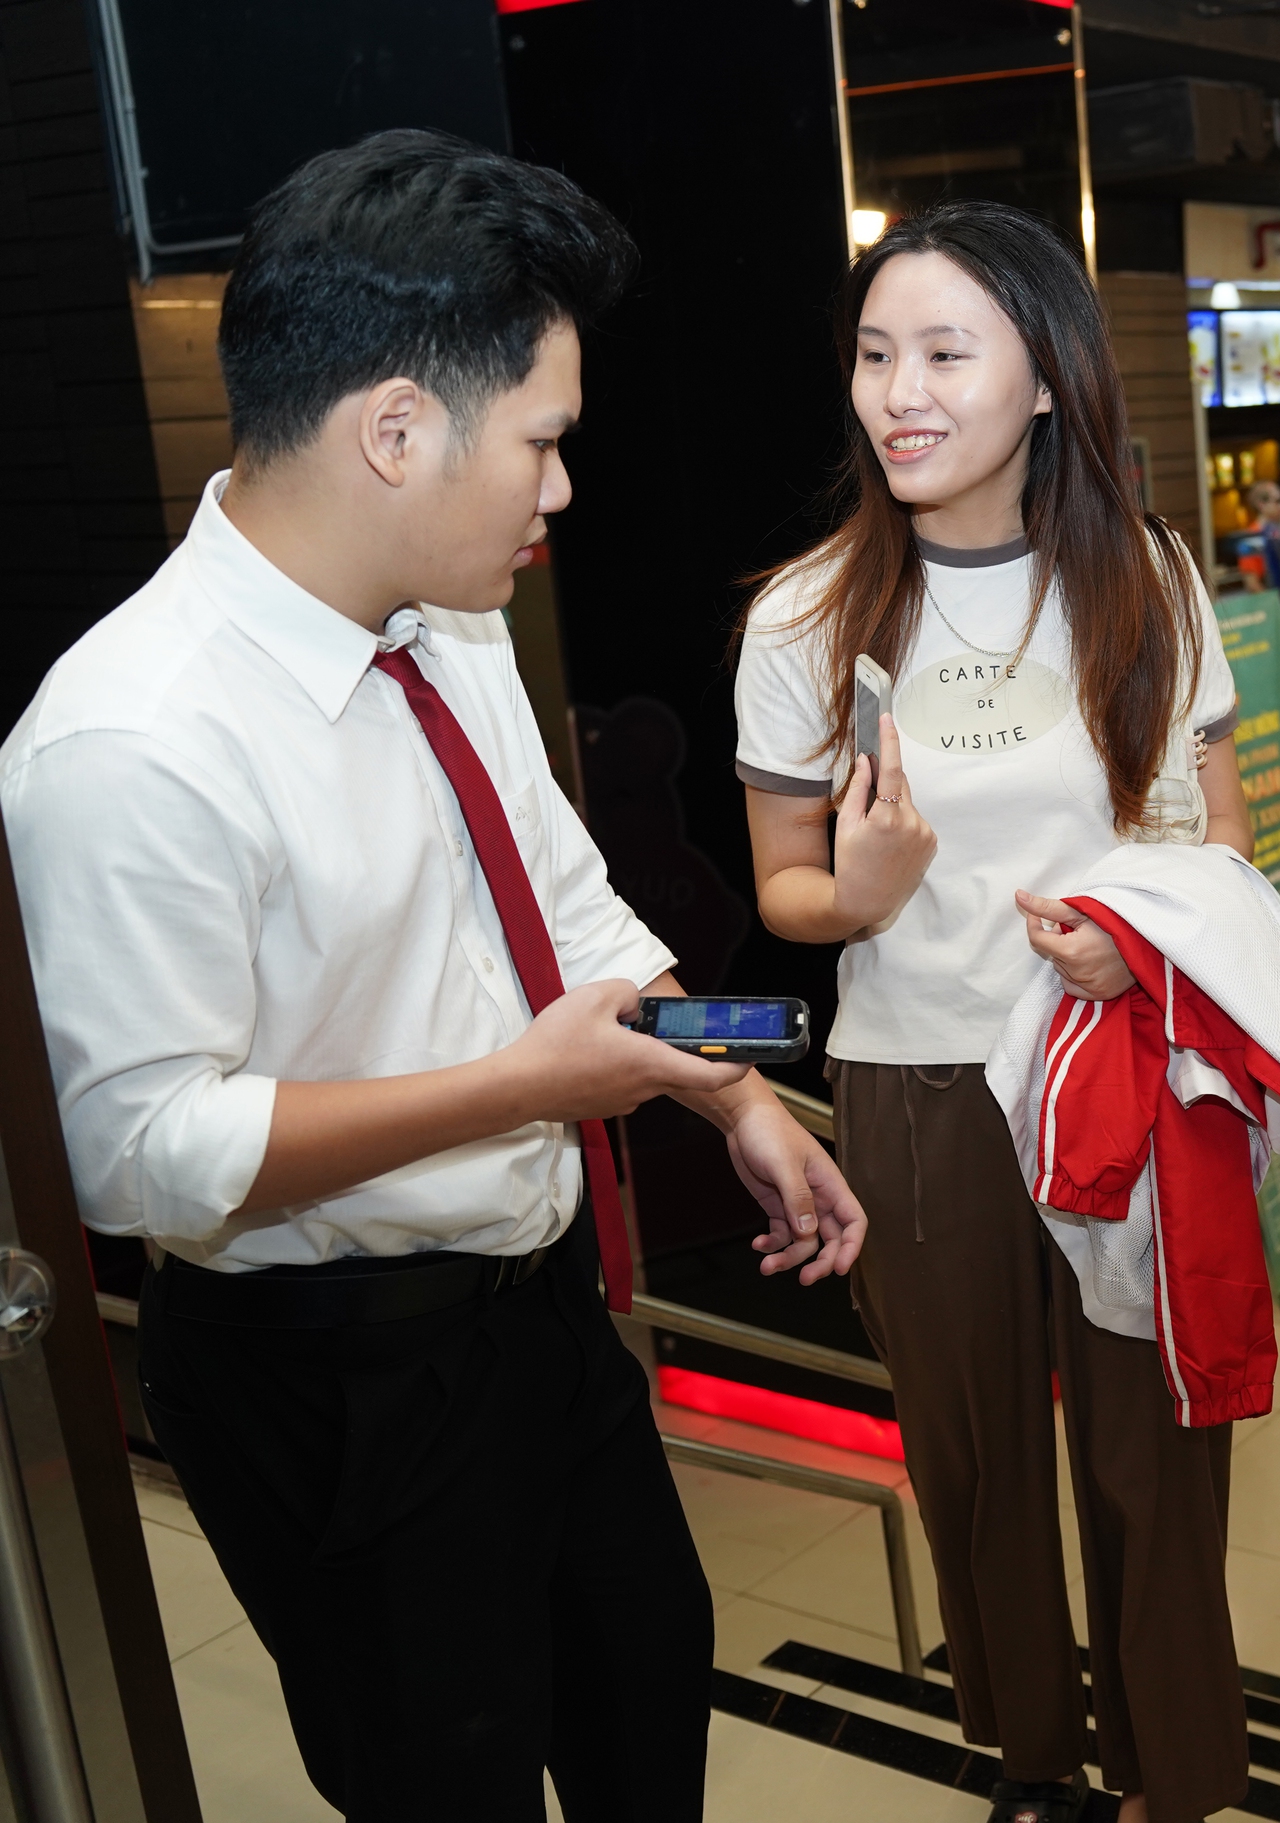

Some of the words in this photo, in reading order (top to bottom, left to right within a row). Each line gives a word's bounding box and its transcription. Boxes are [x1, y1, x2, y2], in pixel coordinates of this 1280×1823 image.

[939, 665, 1017, 683] CARTE
[977, 699, 995, 709] DE
[941, 726, 1027, 749] VISITE
